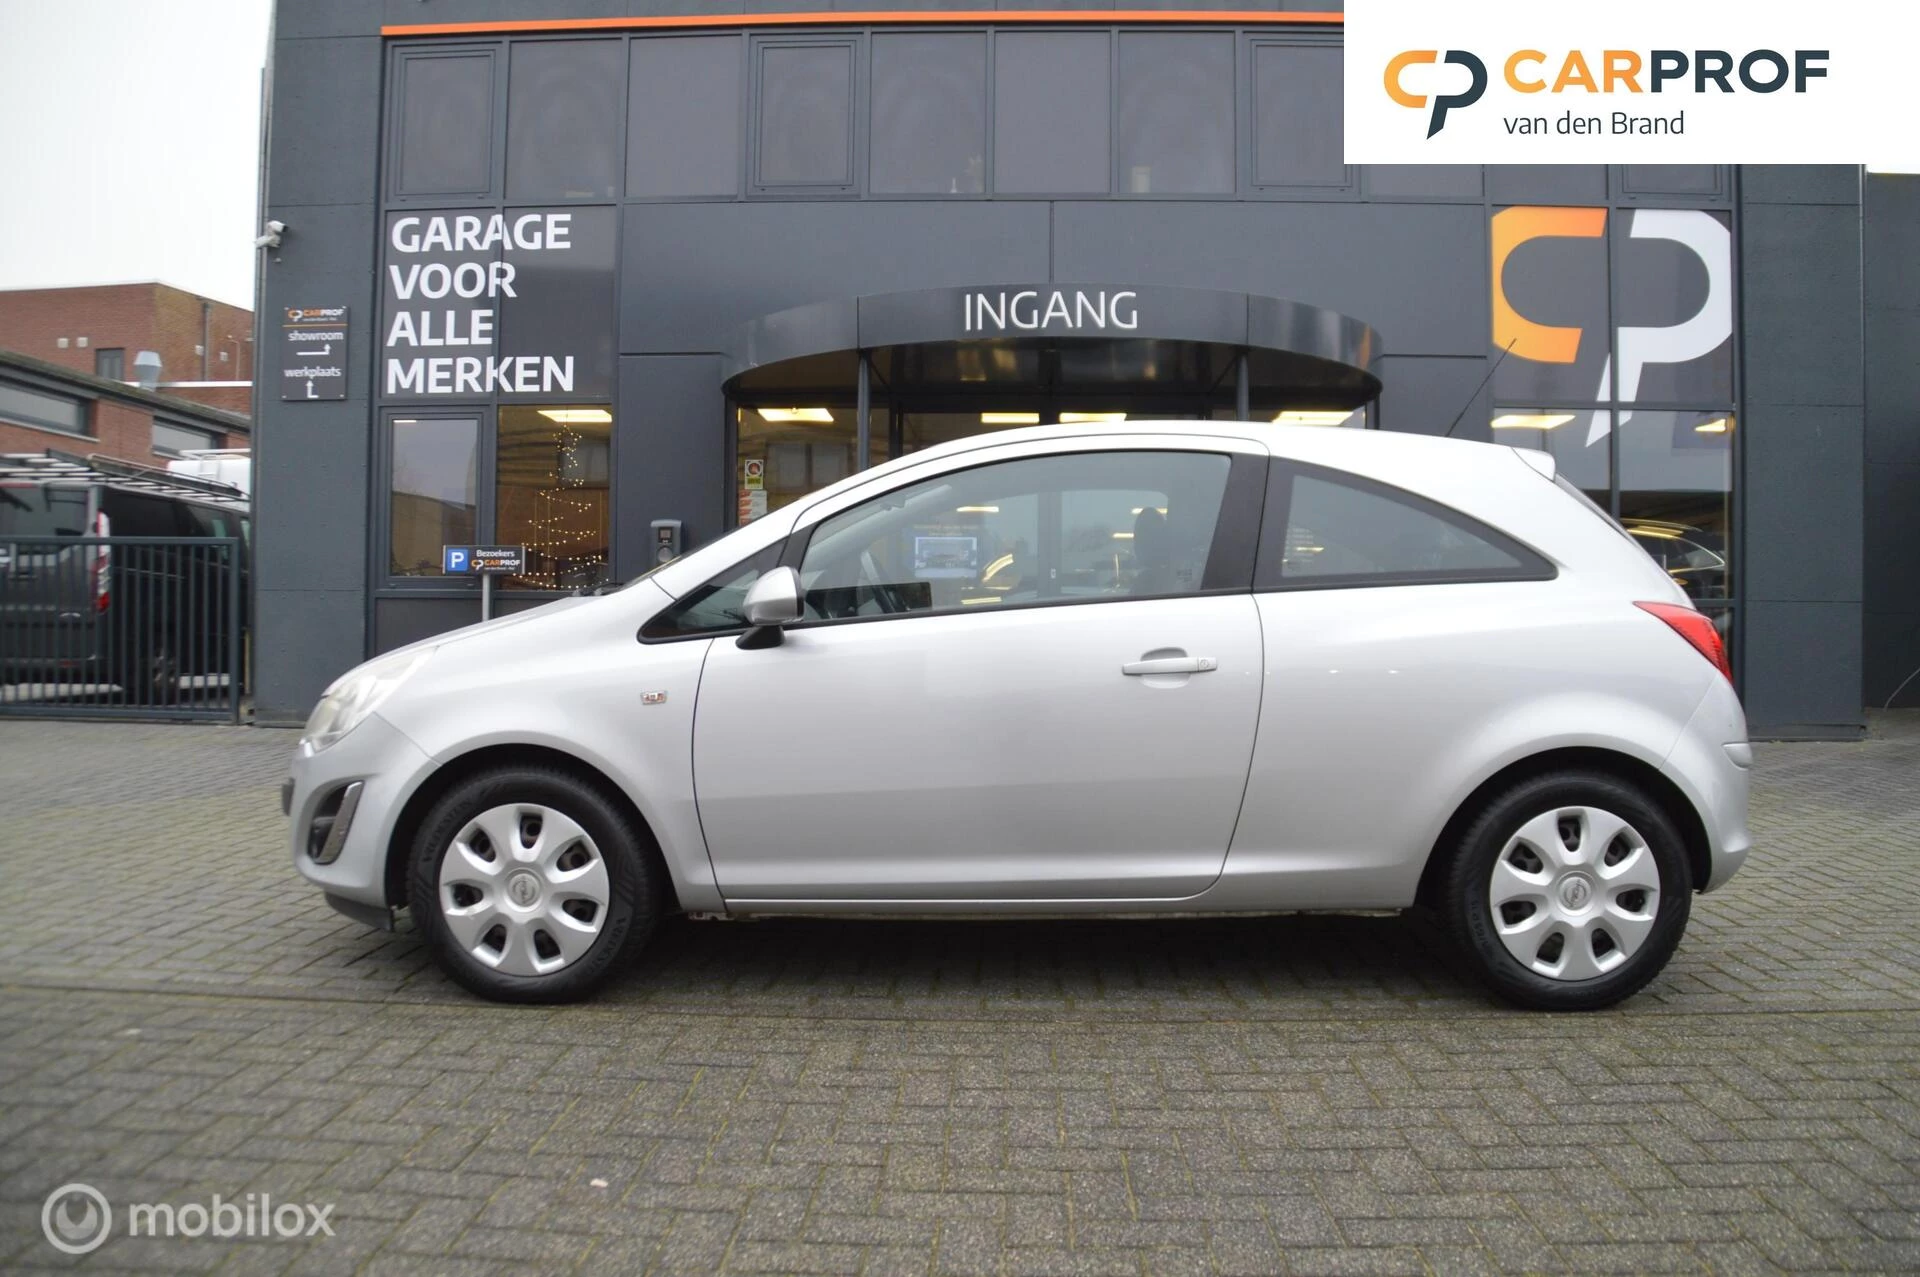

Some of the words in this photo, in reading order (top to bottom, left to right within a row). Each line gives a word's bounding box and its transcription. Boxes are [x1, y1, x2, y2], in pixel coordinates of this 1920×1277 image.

[391, 213, 571, 253] GARAGE
[389, 261, 517, 299] VOOR
[303, 308, 344, 317] CARPROF
[965, 291, 1138, 331] INGANG
[288, 330, 343, 341] showroom
[386, 309, 493, 347] ALLE
[284, 366, 341, 379] werkplaats
[386, 355, 574, 395] MERKEN
[451, 551, 464, 568] P
[476, 549, 515, 557] Bezoekers
